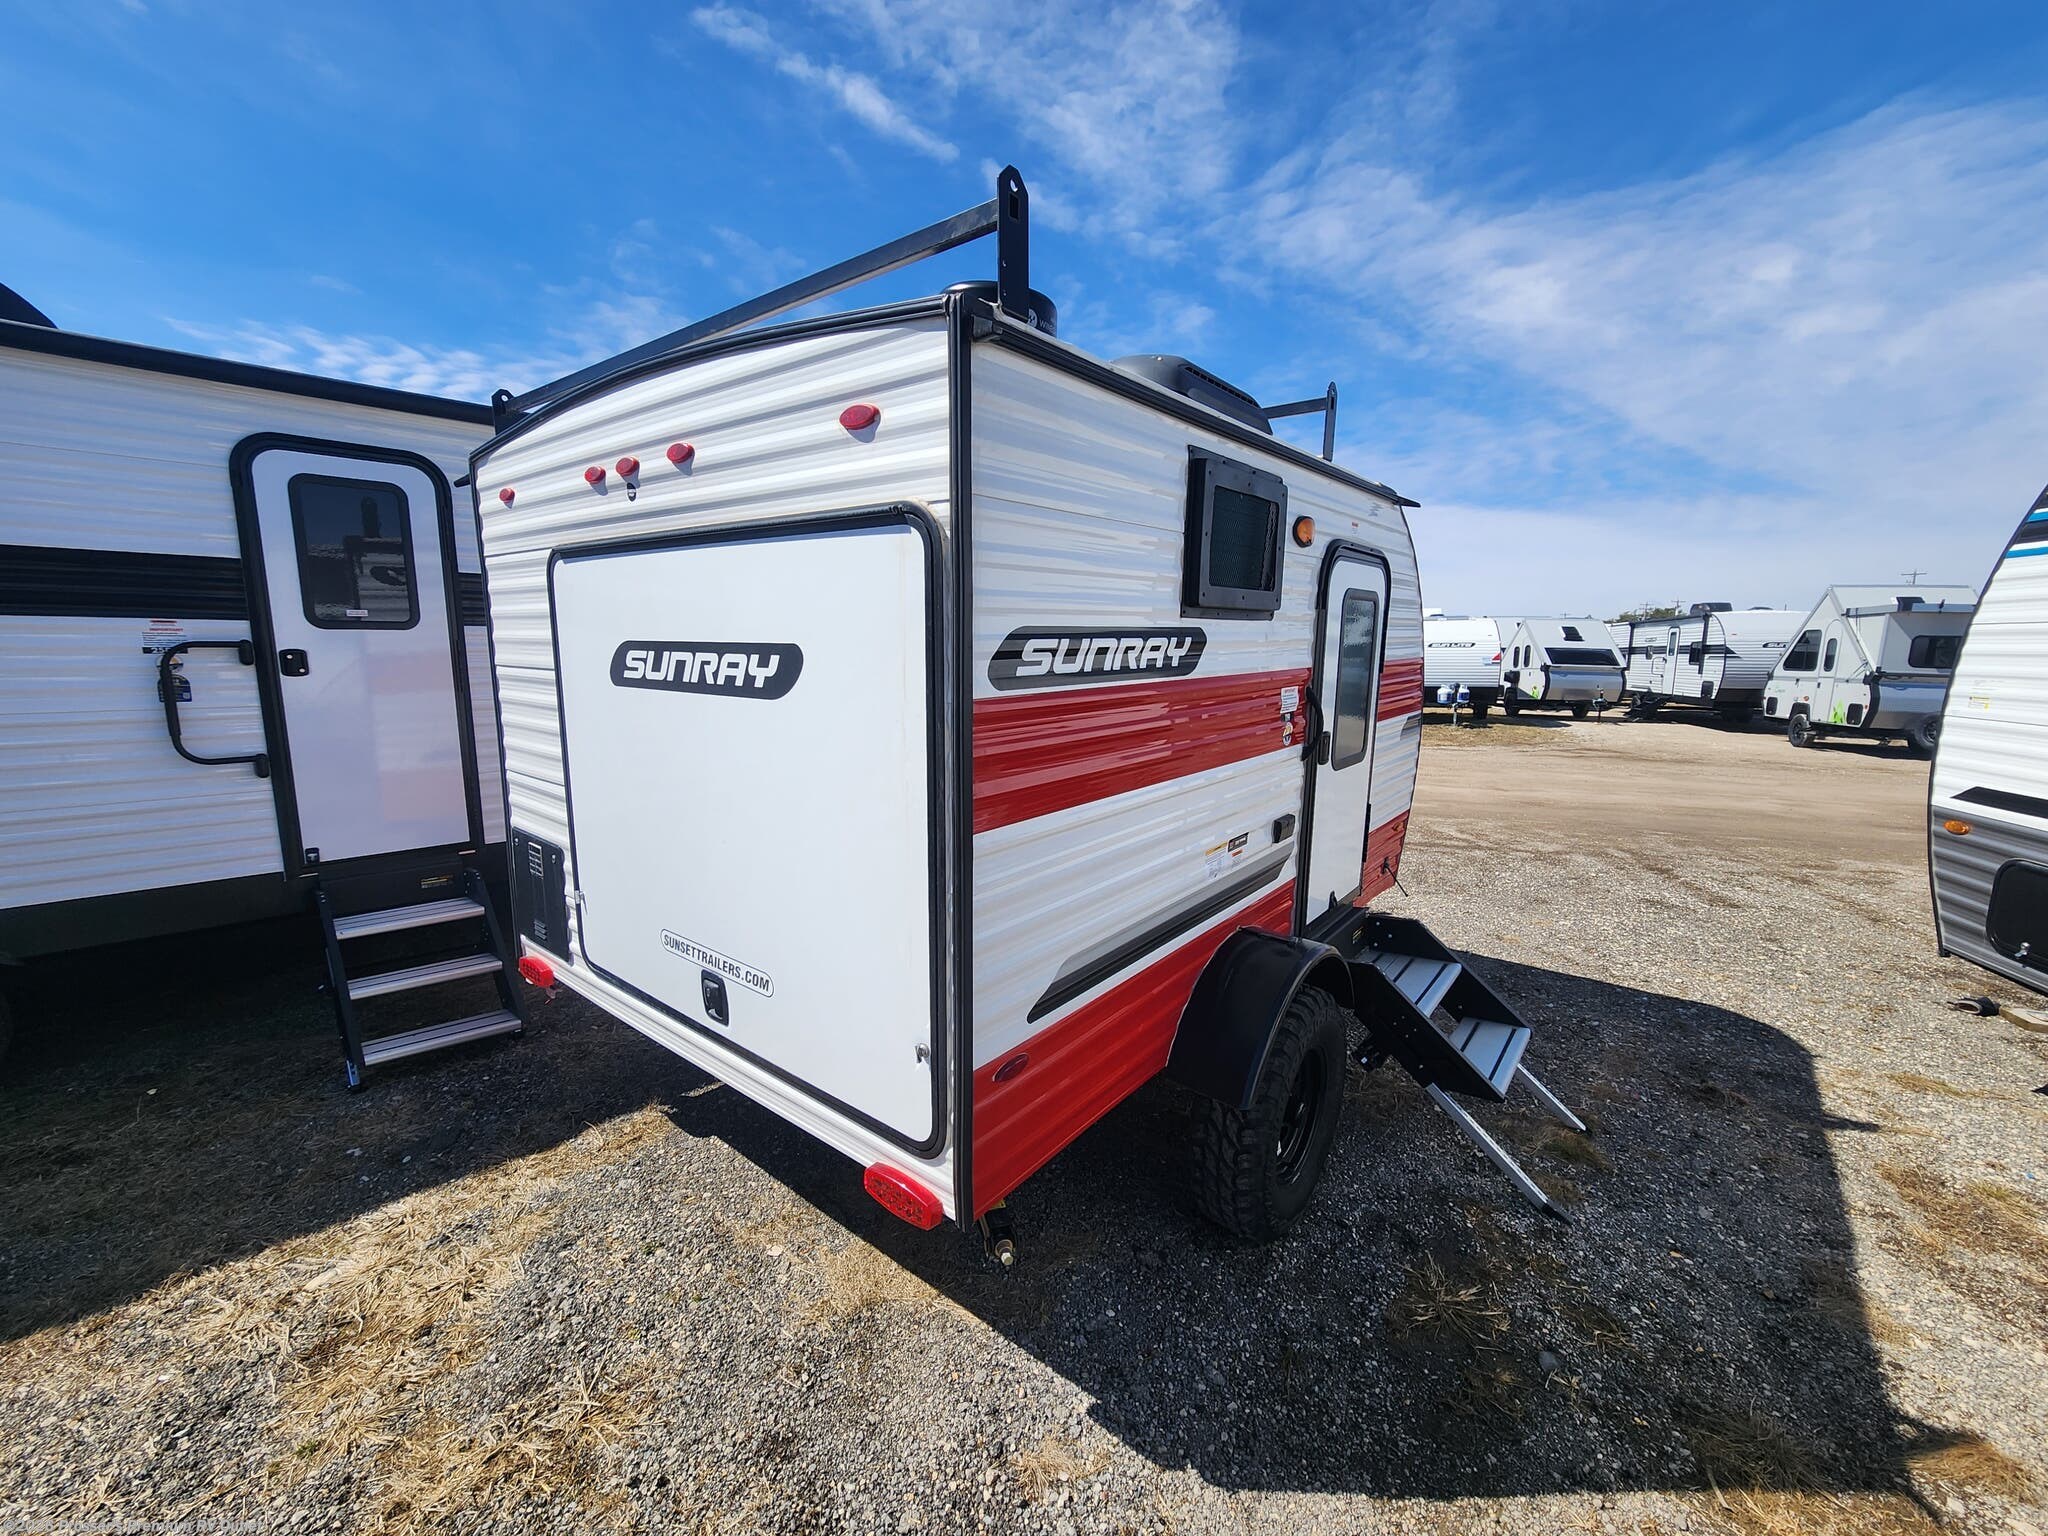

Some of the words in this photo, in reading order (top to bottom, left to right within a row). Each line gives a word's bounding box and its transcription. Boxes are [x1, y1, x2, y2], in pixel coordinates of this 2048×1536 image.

[624, 650, 780, 688] SUNRAY
[1015, 637, 1192, 677] SUNRAY
[664, 934, 770, 992] SUNSETTRAILERS.COM
